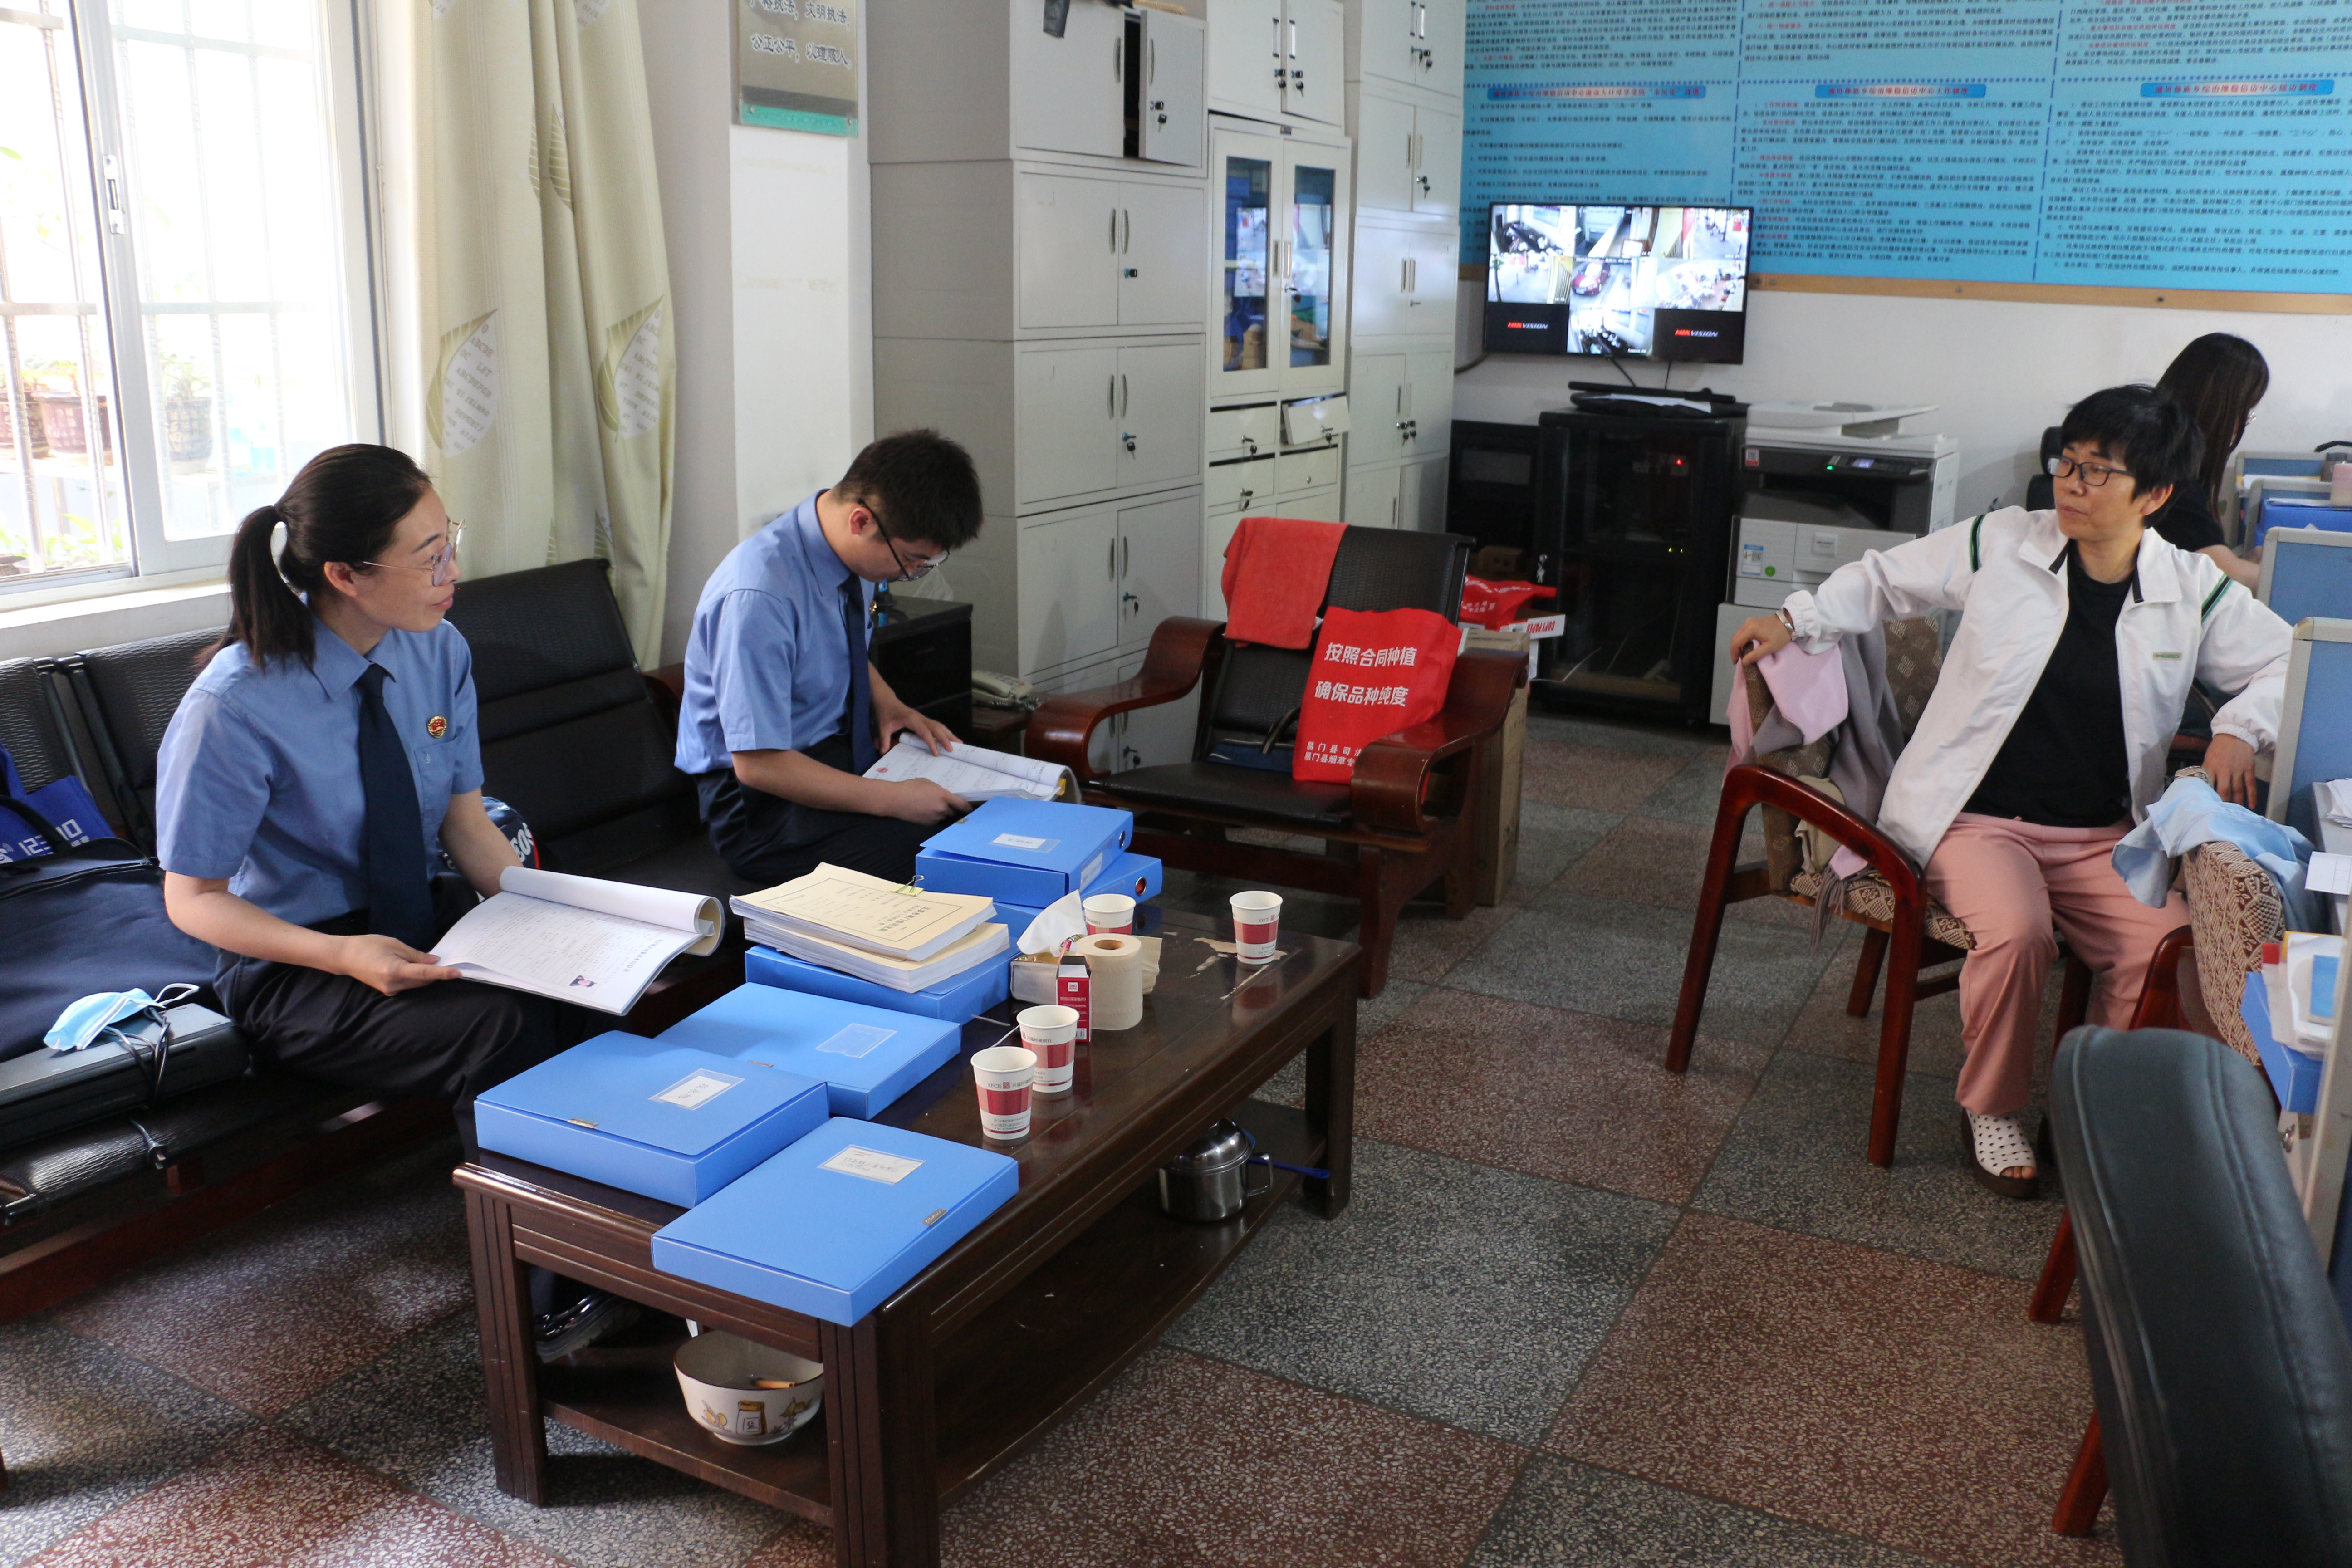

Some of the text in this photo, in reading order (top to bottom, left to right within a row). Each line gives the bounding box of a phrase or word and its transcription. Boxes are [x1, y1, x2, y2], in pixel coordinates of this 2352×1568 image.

[750, 0, 799, 20] 格执法，
[1324, 642, 1417, 667] 按照合同种植
[1314, 681, 1409, 707] 确保品种纯度
